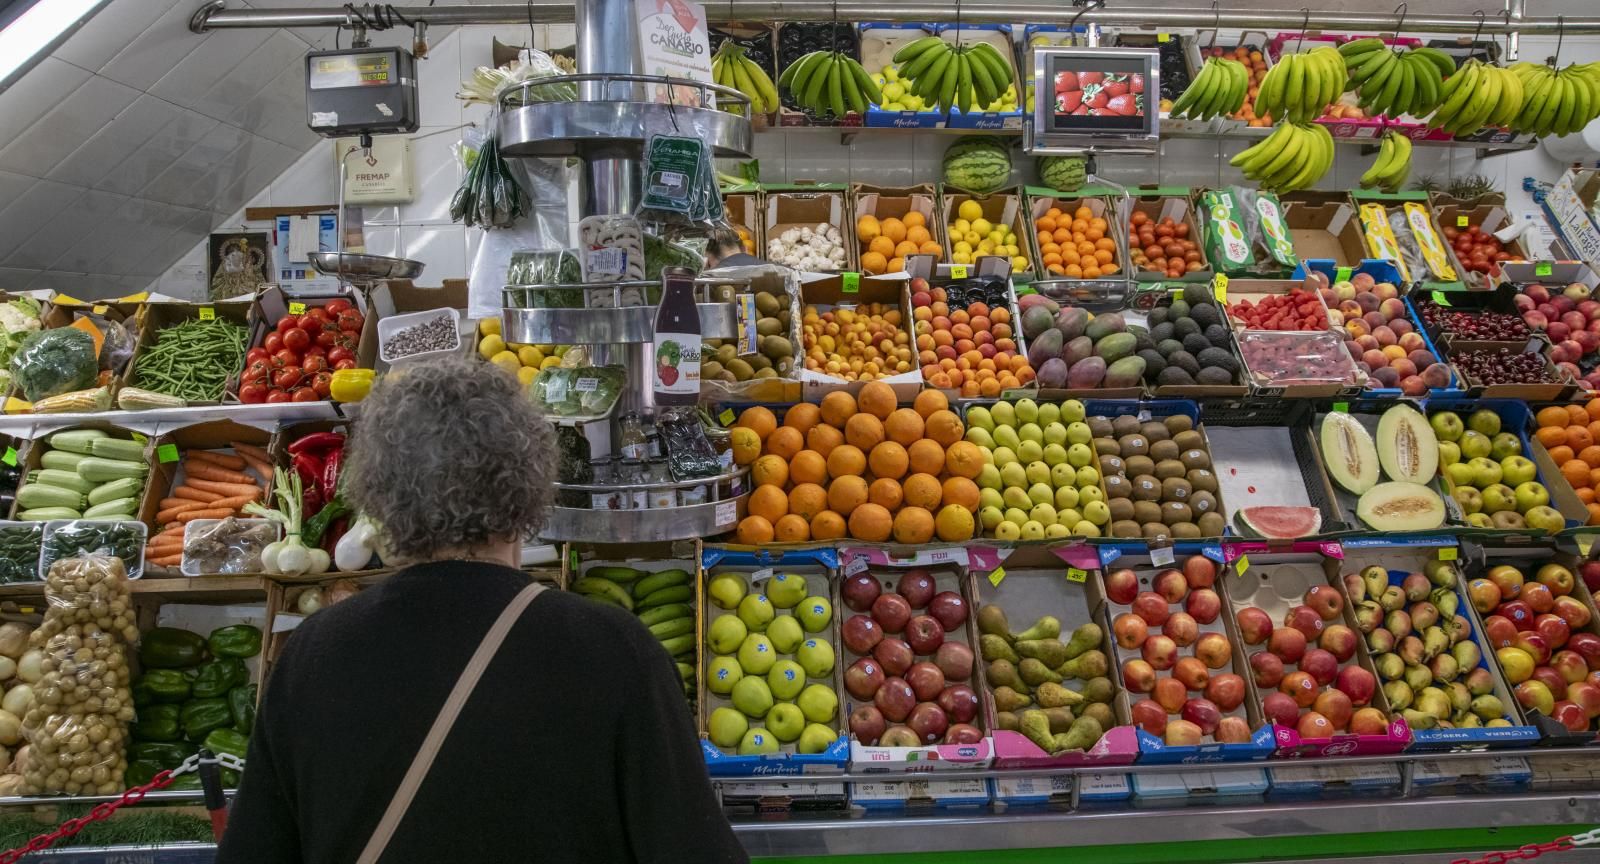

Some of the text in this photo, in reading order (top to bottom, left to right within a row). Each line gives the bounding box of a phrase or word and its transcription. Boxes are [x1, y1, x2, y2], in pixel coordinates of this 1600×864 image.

[650, 33, 704, 55] CANARIO
[355, 172, 390, 182] FREMAP
[1569, 214, 1597, 255] Lairaga
[931, 552, 948, 560] FUJI
